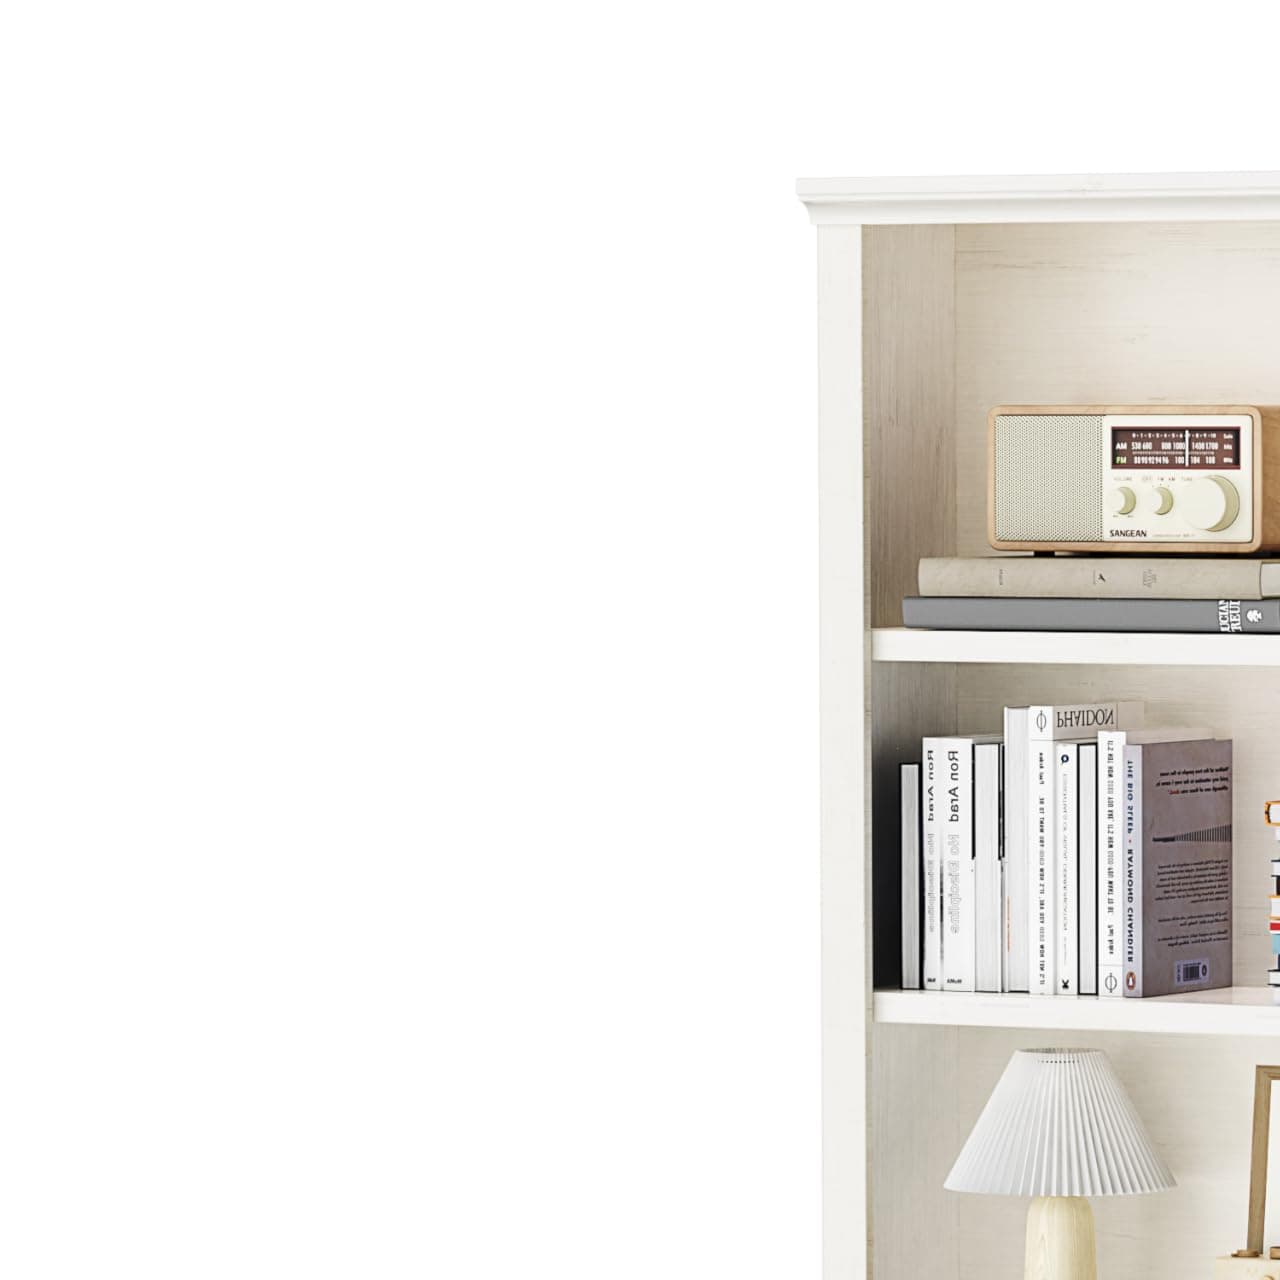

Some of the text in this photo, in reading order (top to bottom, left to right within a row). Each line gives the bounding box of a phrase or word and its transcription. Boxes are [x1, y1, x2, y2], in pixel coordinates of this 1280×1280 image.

[1116, 442, 1127, 450] AM
[1116, 456, 1127, 464] FM
[1109, 529, 1147, 538] SANGEAN
